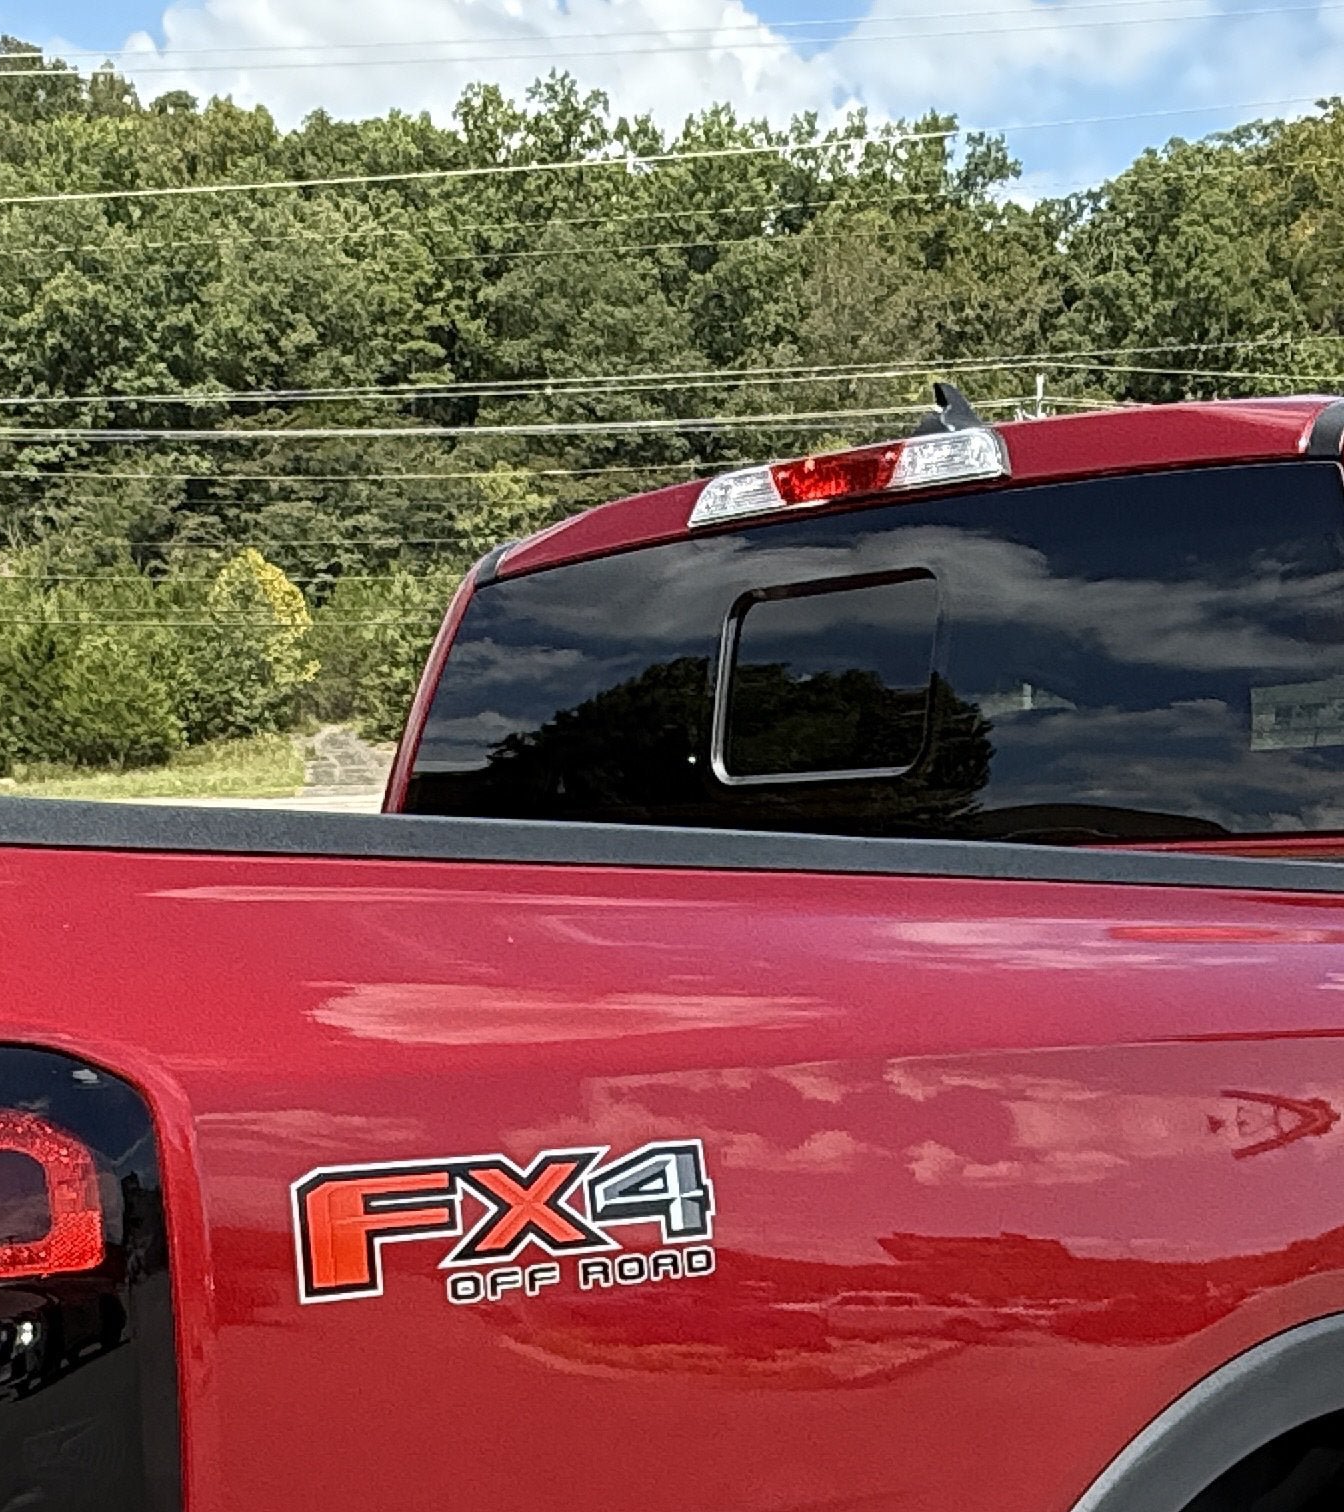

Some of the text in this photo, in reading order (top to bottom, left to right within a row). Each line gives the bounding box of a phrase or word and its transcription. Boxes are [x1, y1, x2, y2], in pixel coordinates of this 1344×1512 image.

[290, 1138, 715, 1305] FX4
[445, 1245, 716, 1305] OFF ROAD
